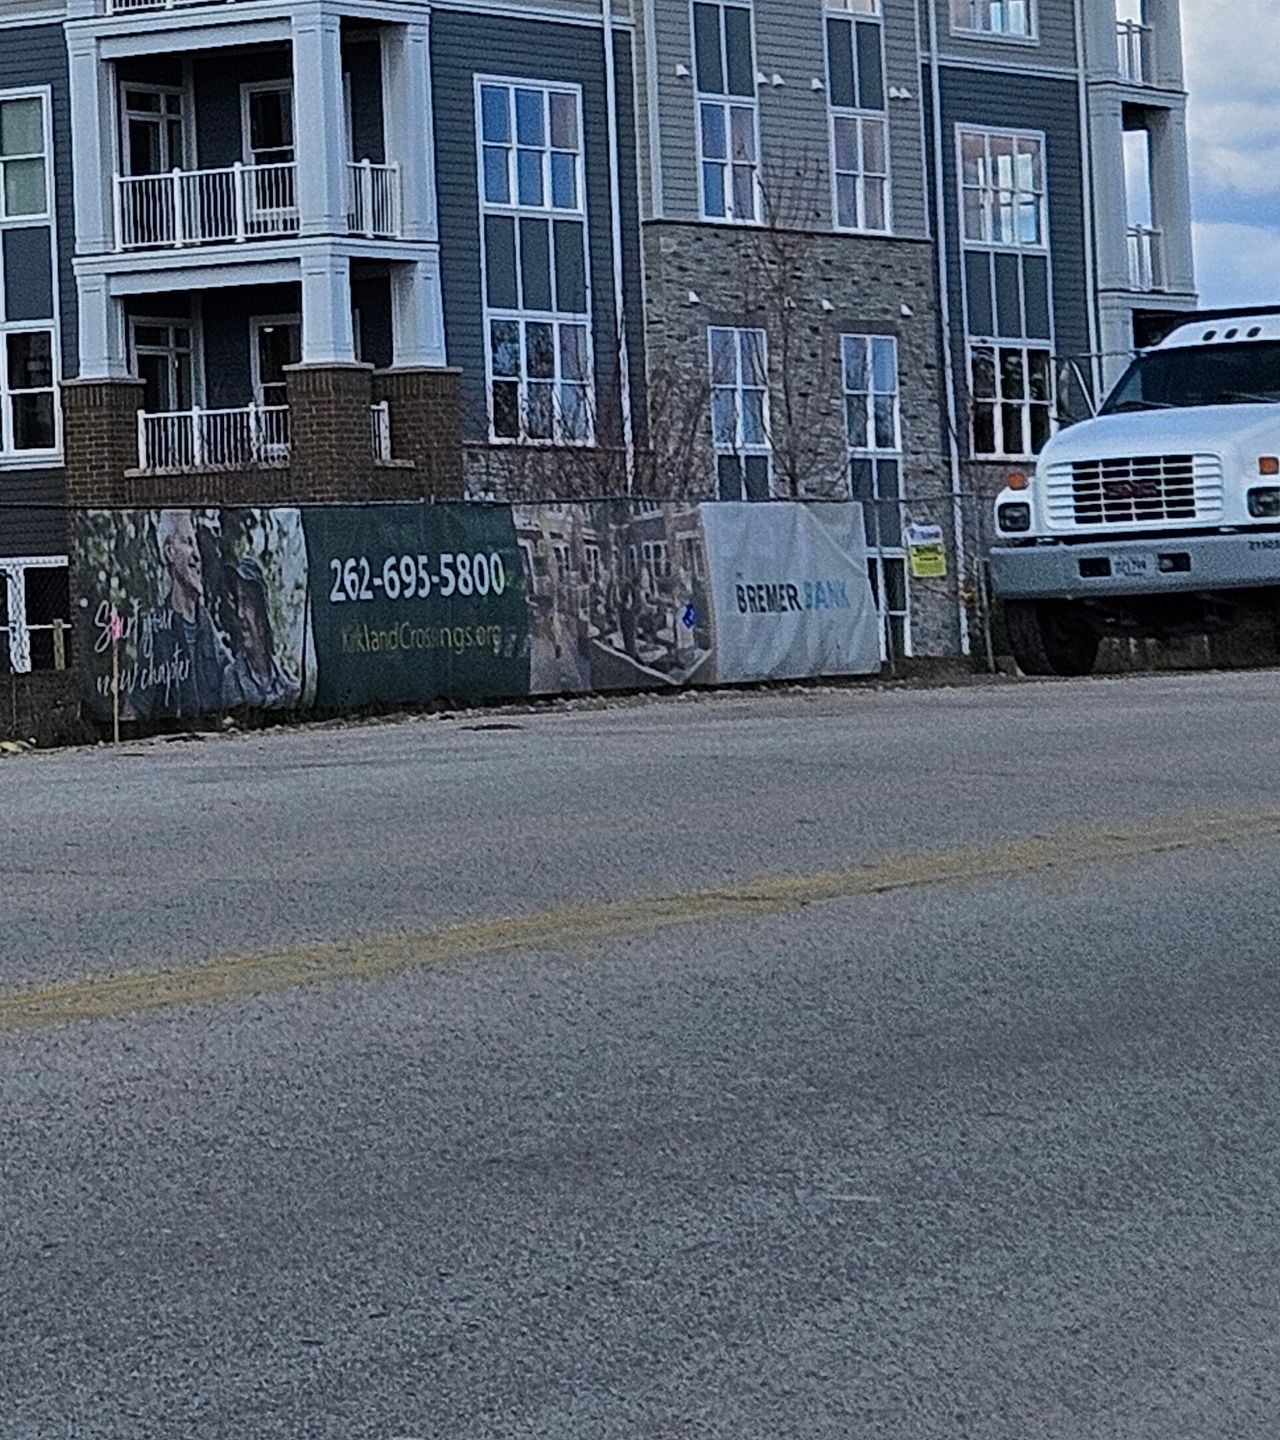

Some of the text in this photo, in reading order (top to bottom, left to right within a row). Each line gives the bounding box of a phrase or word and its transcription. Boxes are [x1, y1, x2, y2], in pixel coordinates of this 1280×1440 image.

[329, 552, 506, 603] 262-695-5800
[735, 583, 802, 614] BREMER
[94, 596, 141, 653] Sart
[97, 662, 139, 697] nw
